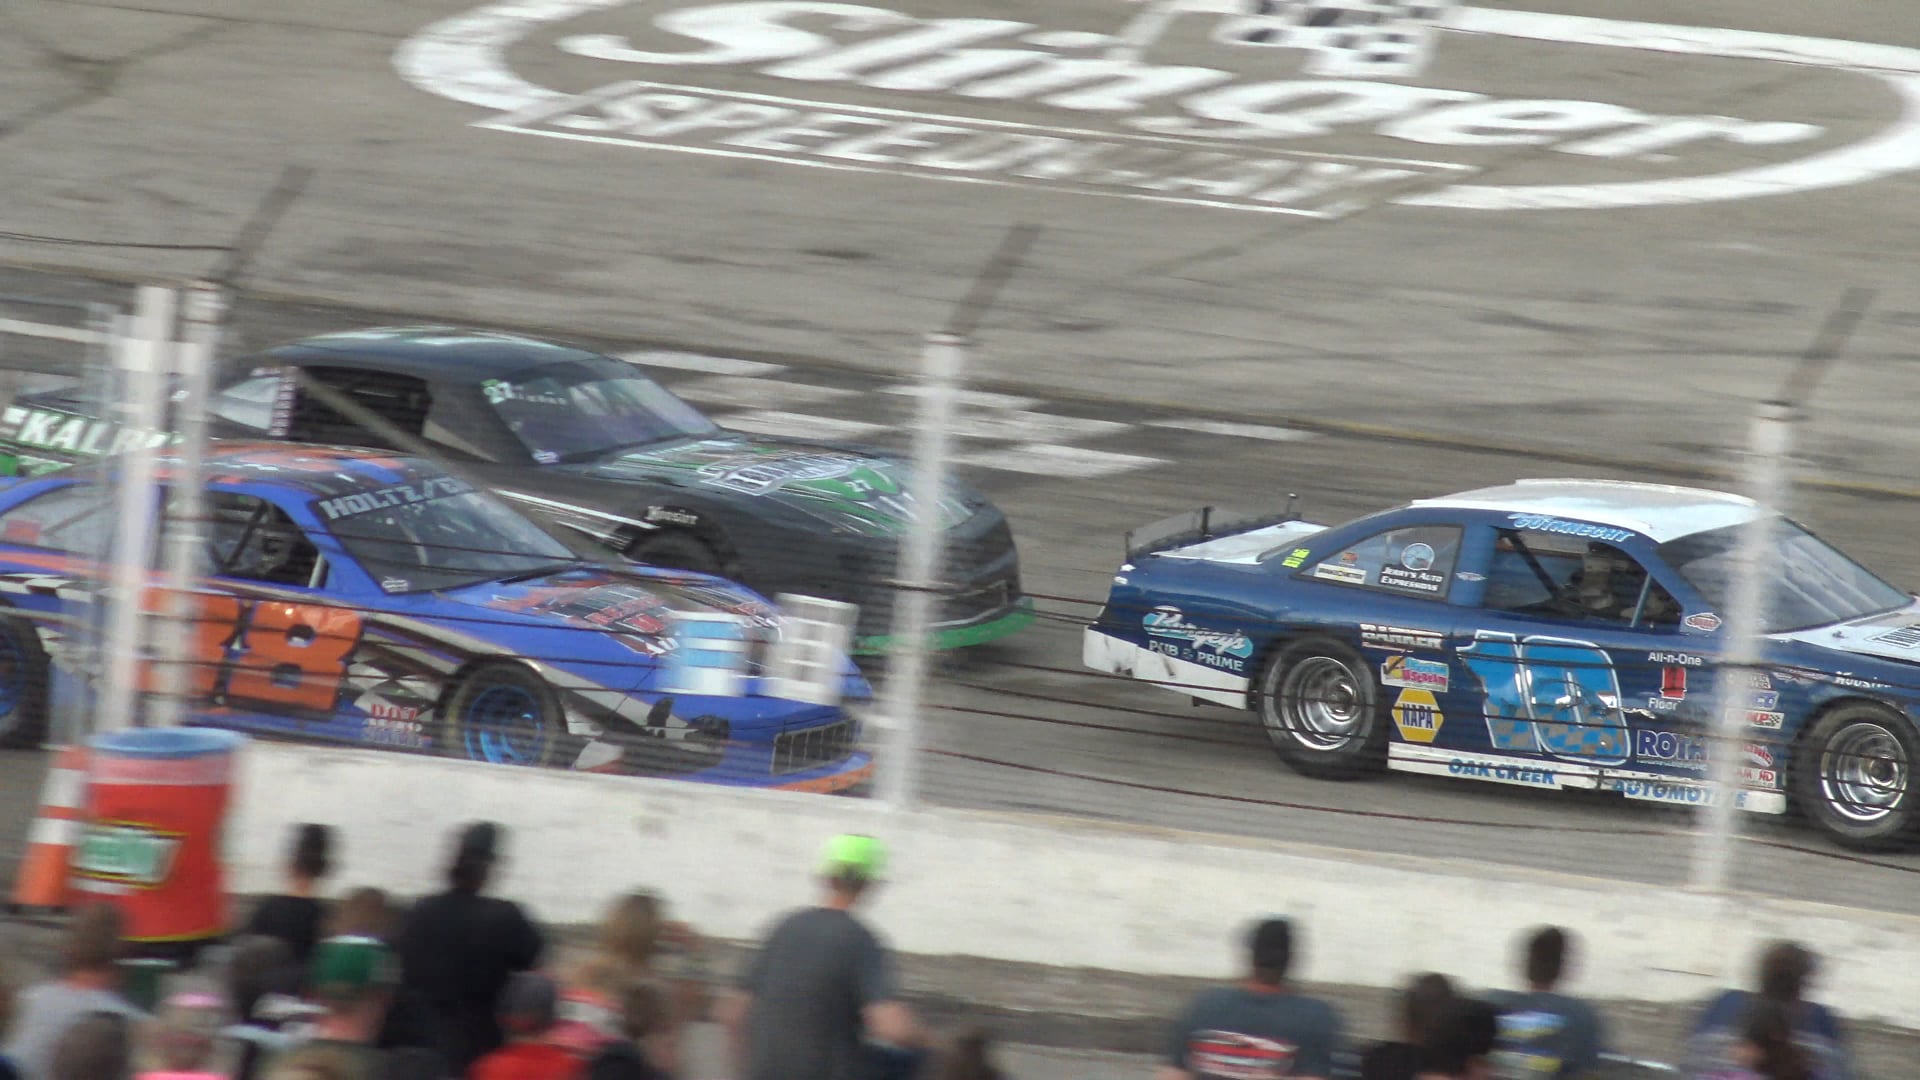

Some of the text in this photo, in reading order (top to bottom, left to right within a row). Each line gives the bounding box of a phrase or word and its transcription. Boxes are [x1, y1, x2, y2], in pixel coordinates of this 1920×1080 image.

[555, 1, 1826, 158] Slinger
[1148, 639, 1179, 657] PUB
[1196, 651, 1244, 672] PRIME
[1648, 651, 1702, 666] All-n-One
[1402, 703, 1434, 729] NAPA
[1648, 697, 1677, 711] Floor
[1447, 758, 1556, 787] OAK CREEK
[1612, 781, 1748, 808] AUTOMOTE
